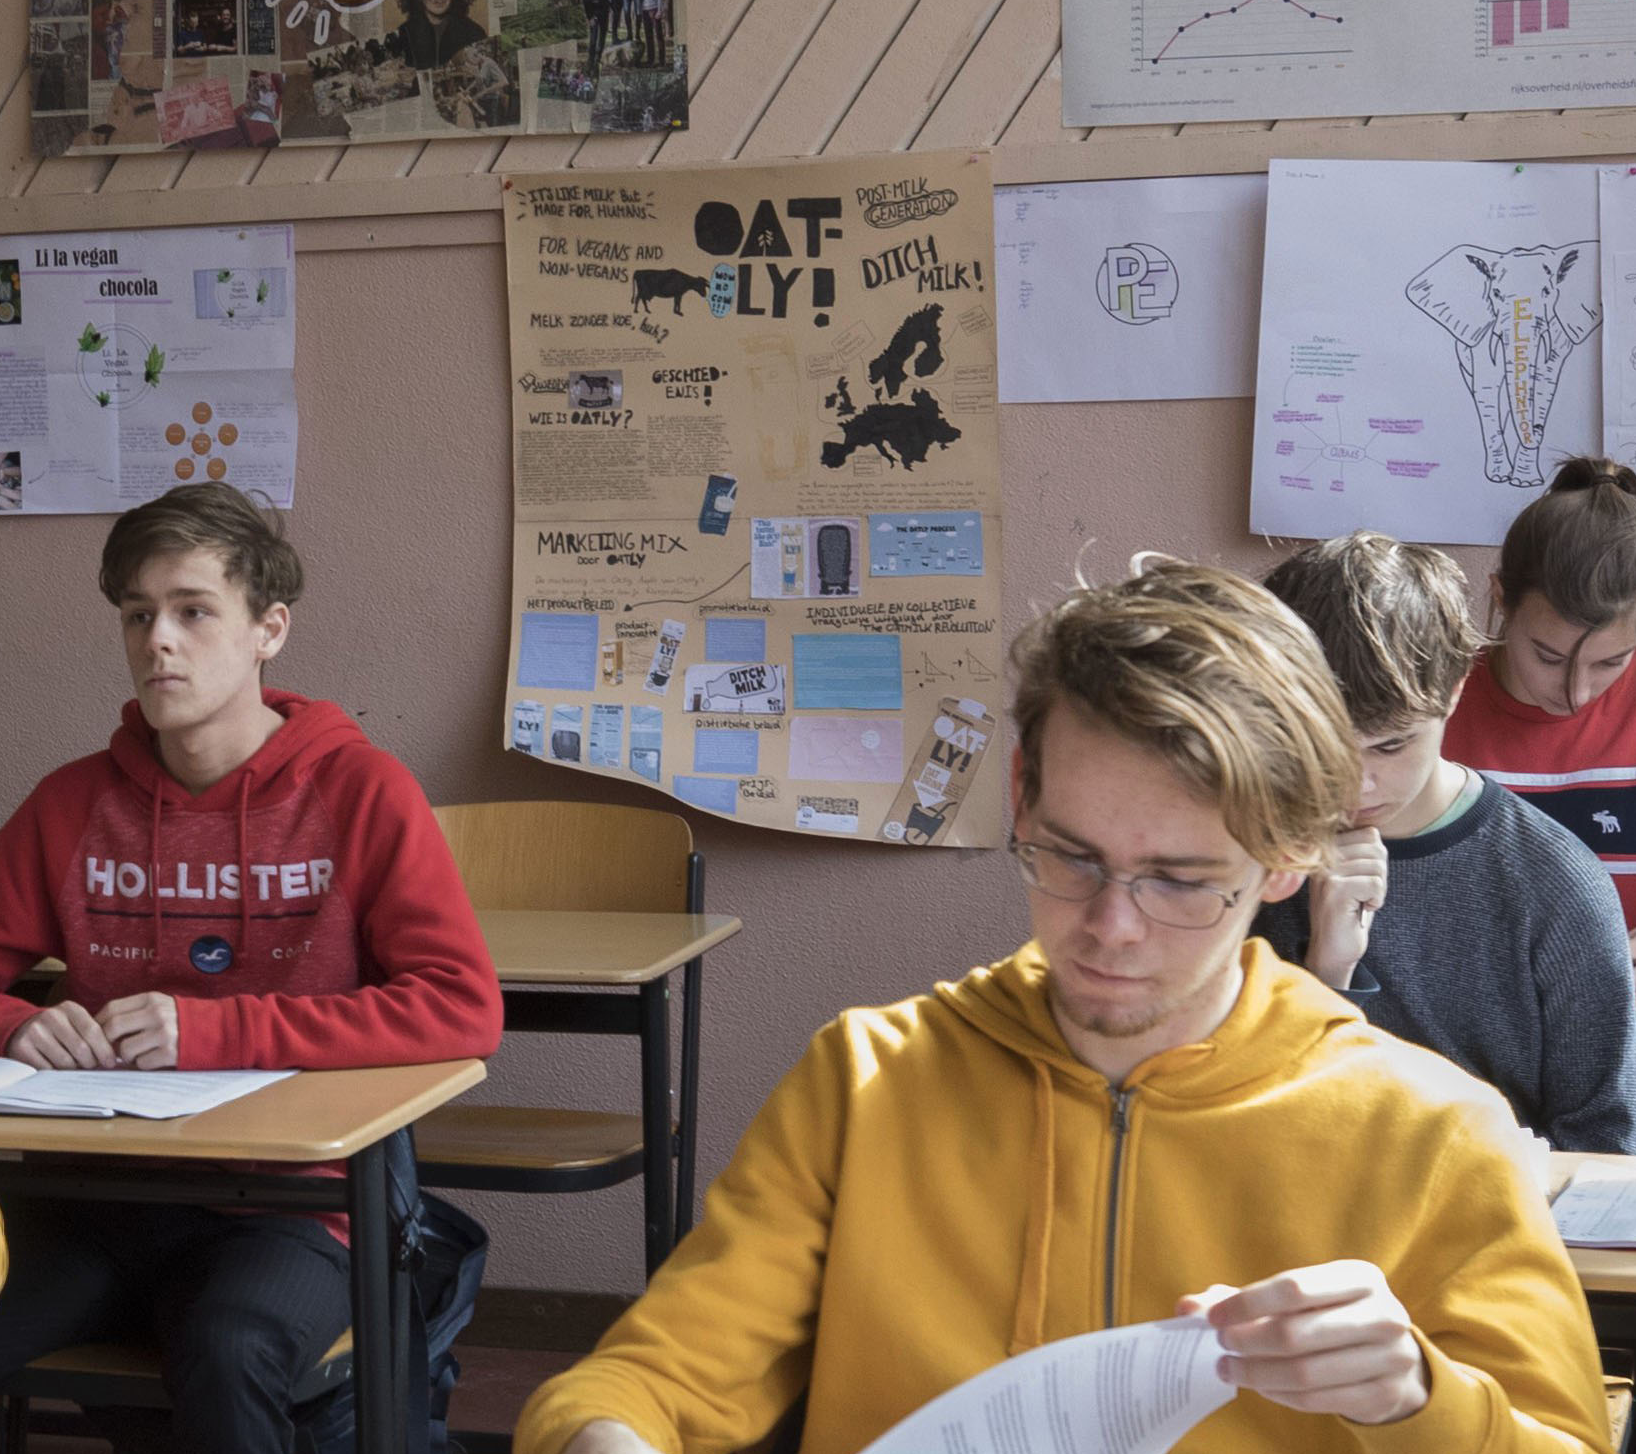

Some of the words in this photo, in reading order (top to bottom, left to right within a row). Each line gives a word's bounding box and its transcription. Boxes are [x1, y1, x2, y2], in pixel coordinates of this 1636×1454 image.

[856, 177, 929, 205] POST-MILK
[870, 195, 952, 223] GENERATION
[35, 249, 50, 267] Li
[53, 249, 67, 266] la
[72, 248, 118, 268] vegan
[539, 237, 568, 254] FOR
[577, 239, 630, 260] VEGANS
[636, 246, 663, 260] AND
[539, 261, 629, 282] NON-VEGANS
[862, 235, 938, 289] DITCH
[99, 278, 158, 297] chocola
[918, 261, 983, 293] MILK!
[737, 263, 835, 327] LY!
[652, 367, 728, 383] GESCHIED-
[538, 532, 635, 554] MARKETING
[641, 534, 688, 553] MIX
[729, 668, 766, 685] DITCH
[735, 680, 766, 696] MILK
[929, 739, 973, 773] LY!
[86, 856, 333, 900] HOLLISTER
